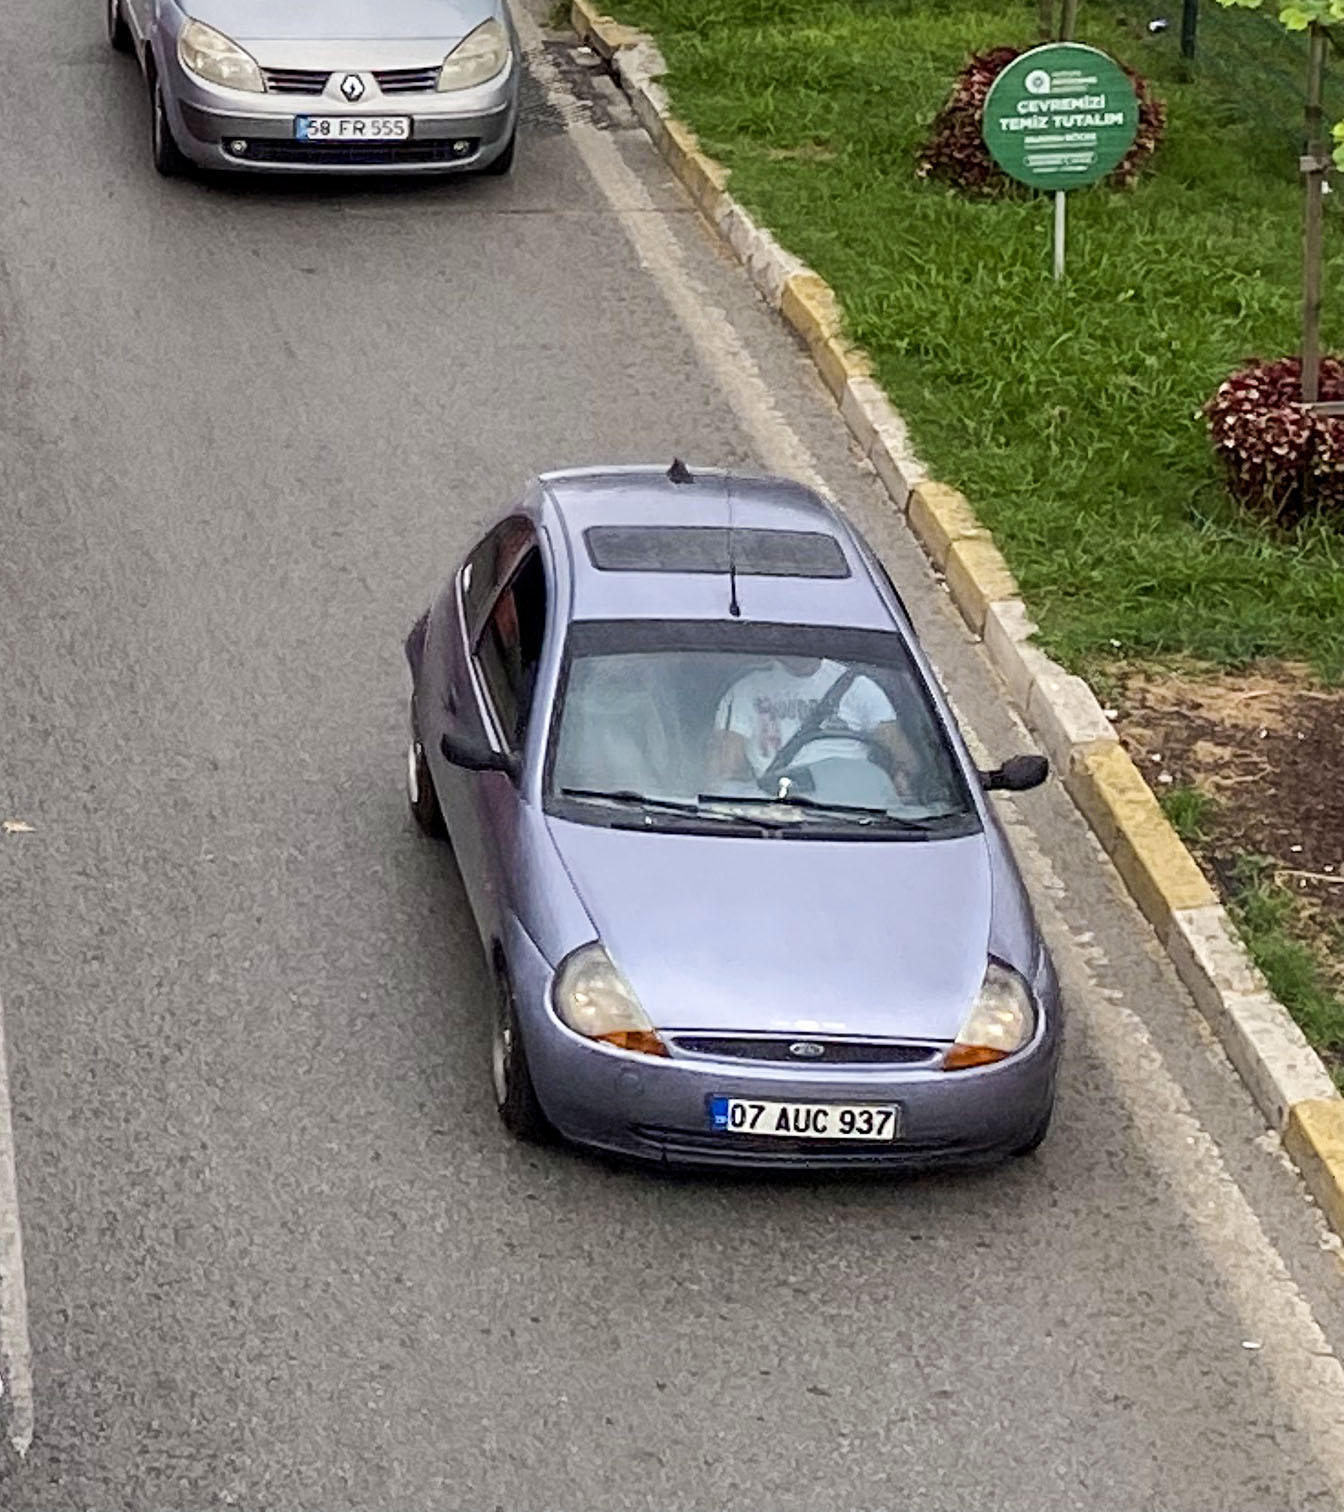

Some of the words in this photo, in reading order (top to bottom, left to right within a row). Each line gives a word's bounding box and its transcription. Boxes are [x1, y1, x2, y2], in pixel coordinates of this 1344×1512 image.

[1016, 94, 1106, 115] ÇEVREMİZİ
[999, 115, 1049, 131] TEMİZ
[1053, 112, 1124, 128] TUTALIM
[730, 1104, 766, 1130] 07
[775, 1107, 829, 1133] AUC
[839, 1109, 893, 1136] 937
